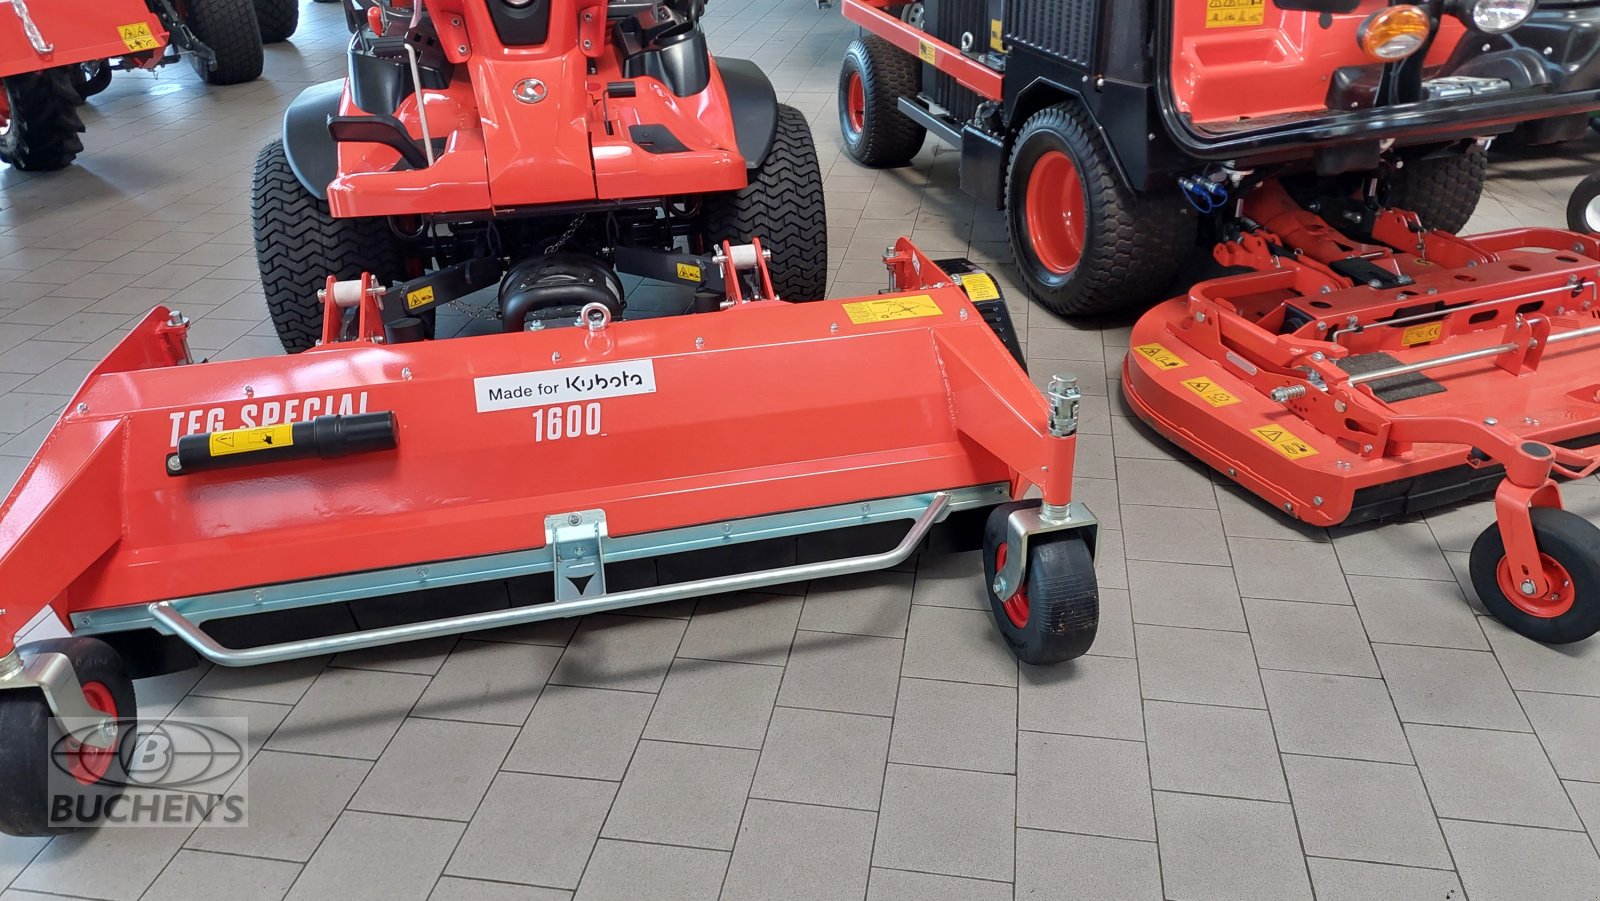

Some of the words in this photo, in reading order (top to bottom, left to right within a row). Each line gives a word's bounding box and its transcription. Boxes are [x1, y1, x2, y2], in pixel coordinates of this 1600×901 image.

[488, 386, 533, 401] Made
[537, 383, 560, 396] for
[565, 370, 643, 392] Kubota
[532, 402, 601, 442] 1600
